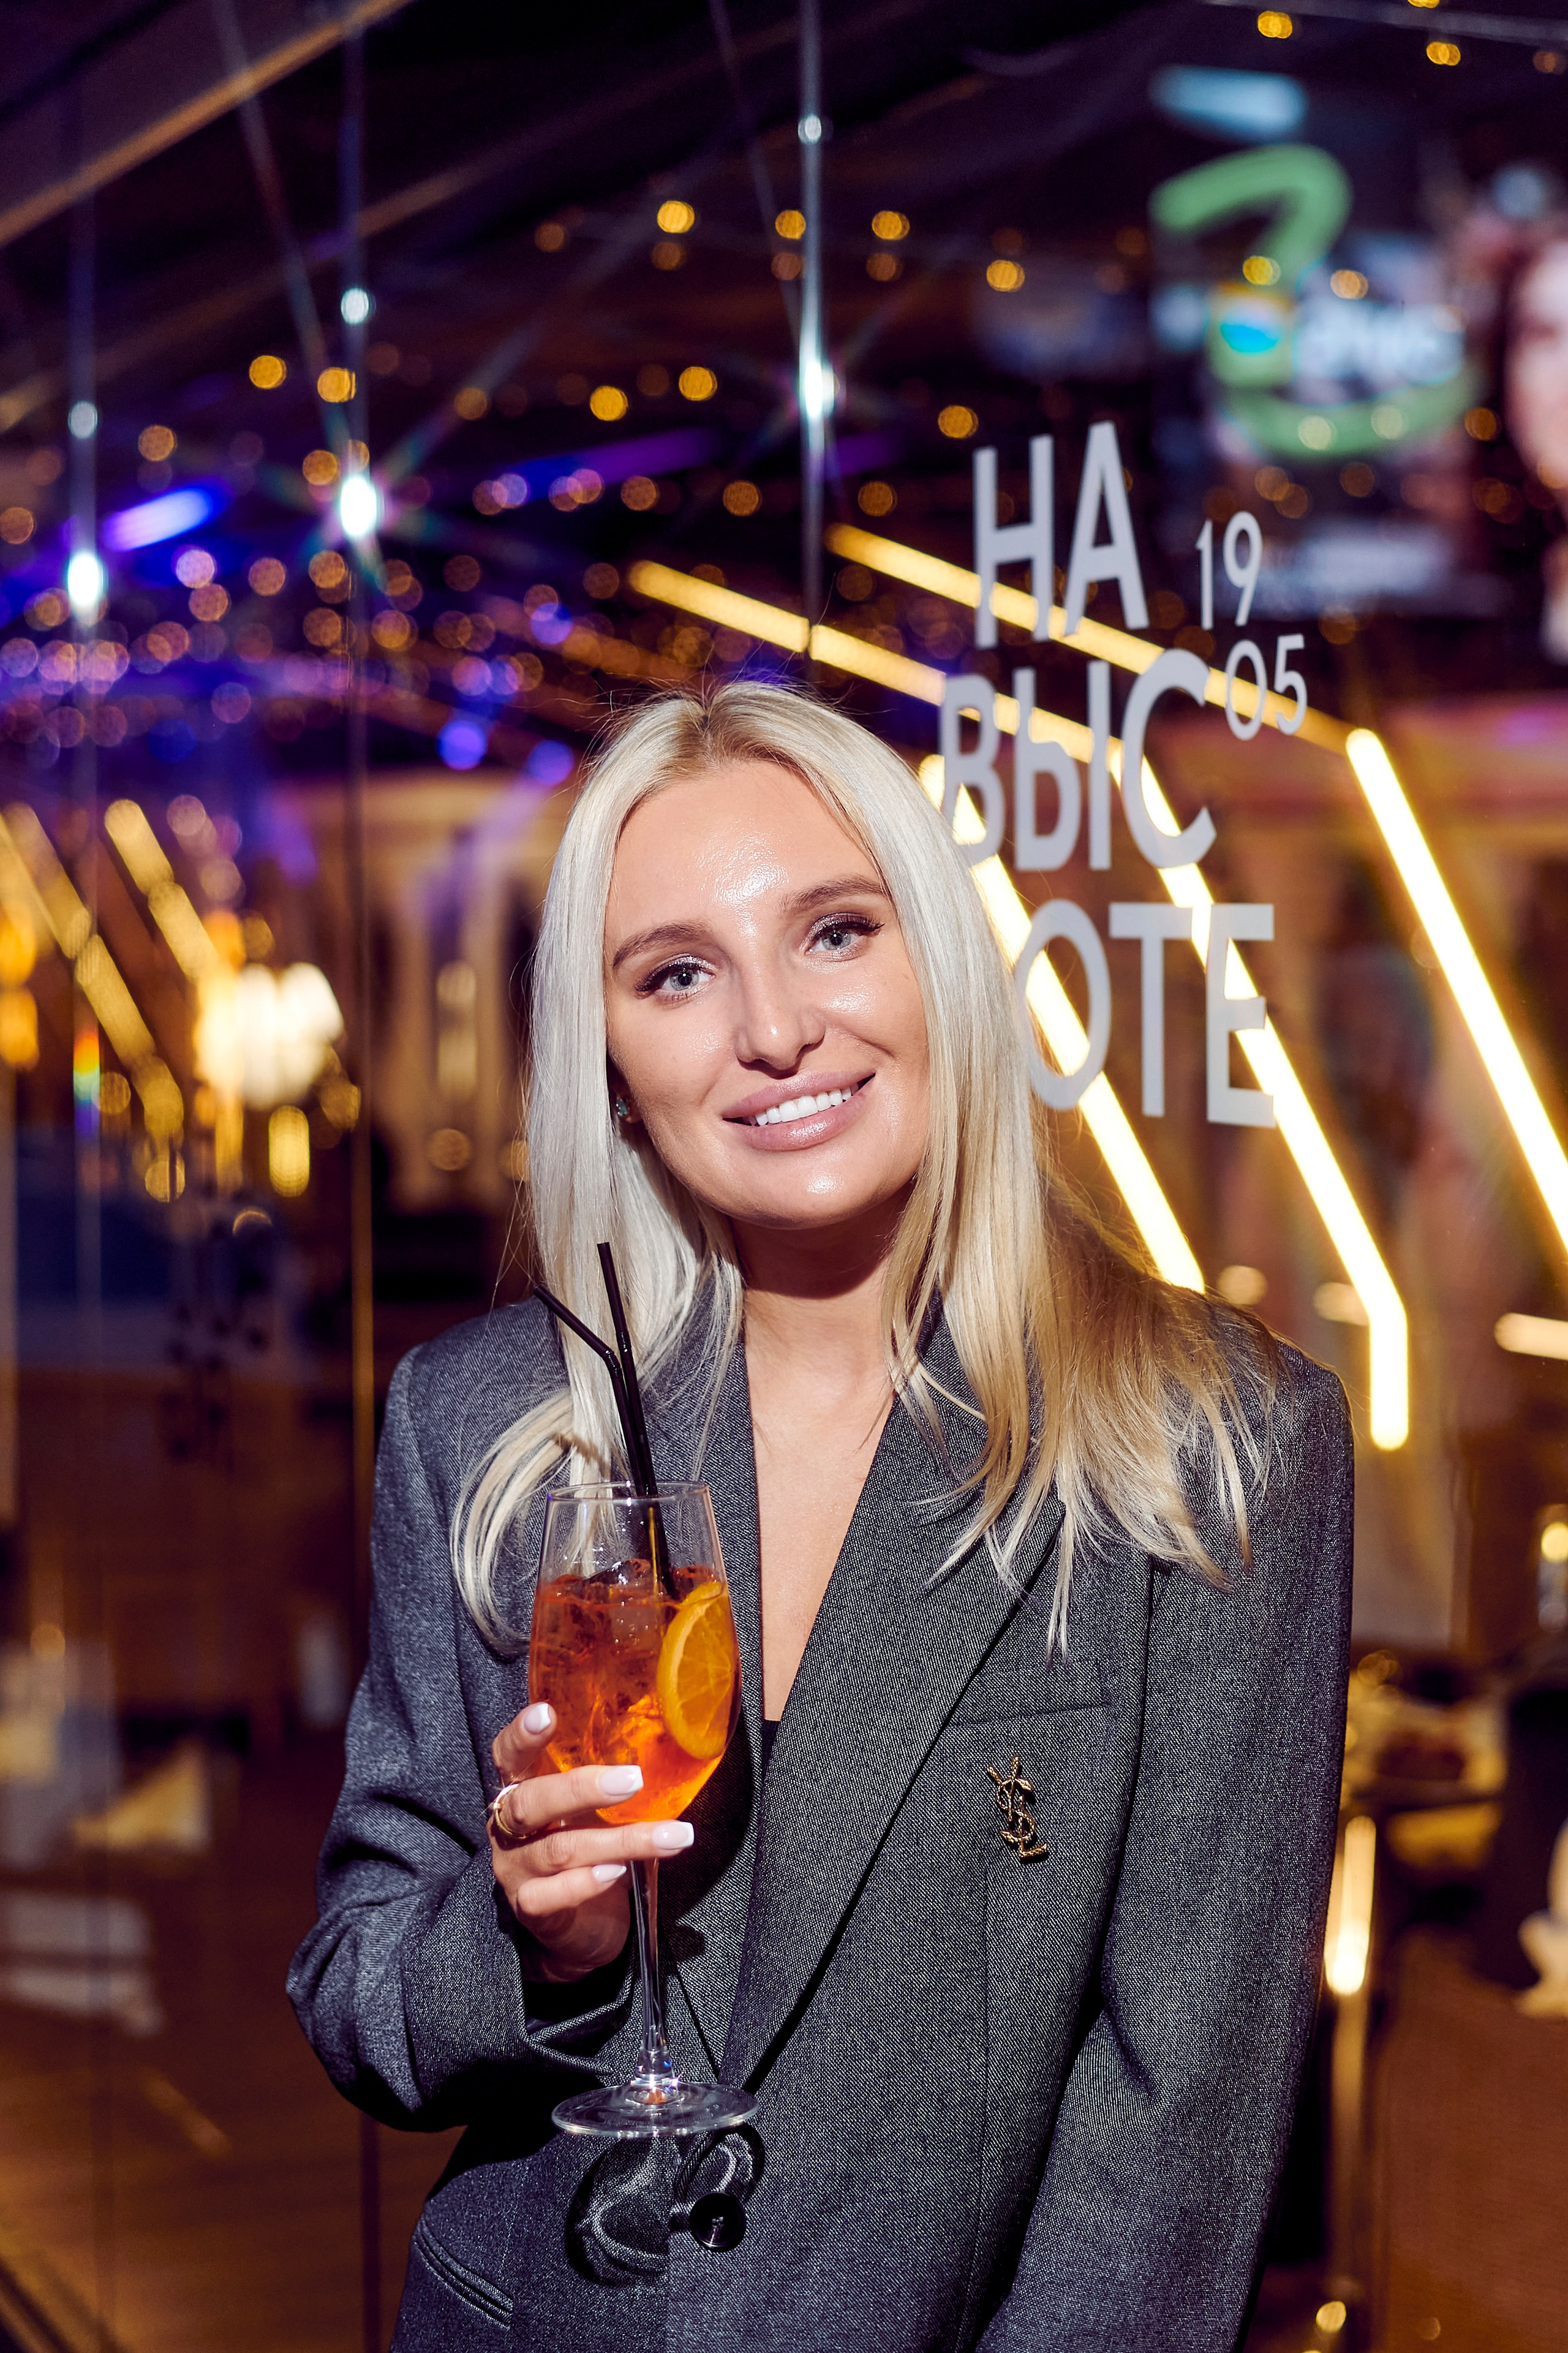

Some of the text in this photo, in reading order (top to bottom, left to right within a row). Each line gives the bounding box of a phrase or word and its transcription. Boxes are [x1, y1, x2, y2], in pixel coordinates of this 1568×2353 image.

[973, 421, 1149, 649] НА
[1196, 511, 1263, 630] 19
[940, 648, 1216, 871] ВЫС
[1226, 633, 1307, 740] 05
[1014, 899, 1276, 1128] ОТЕ
